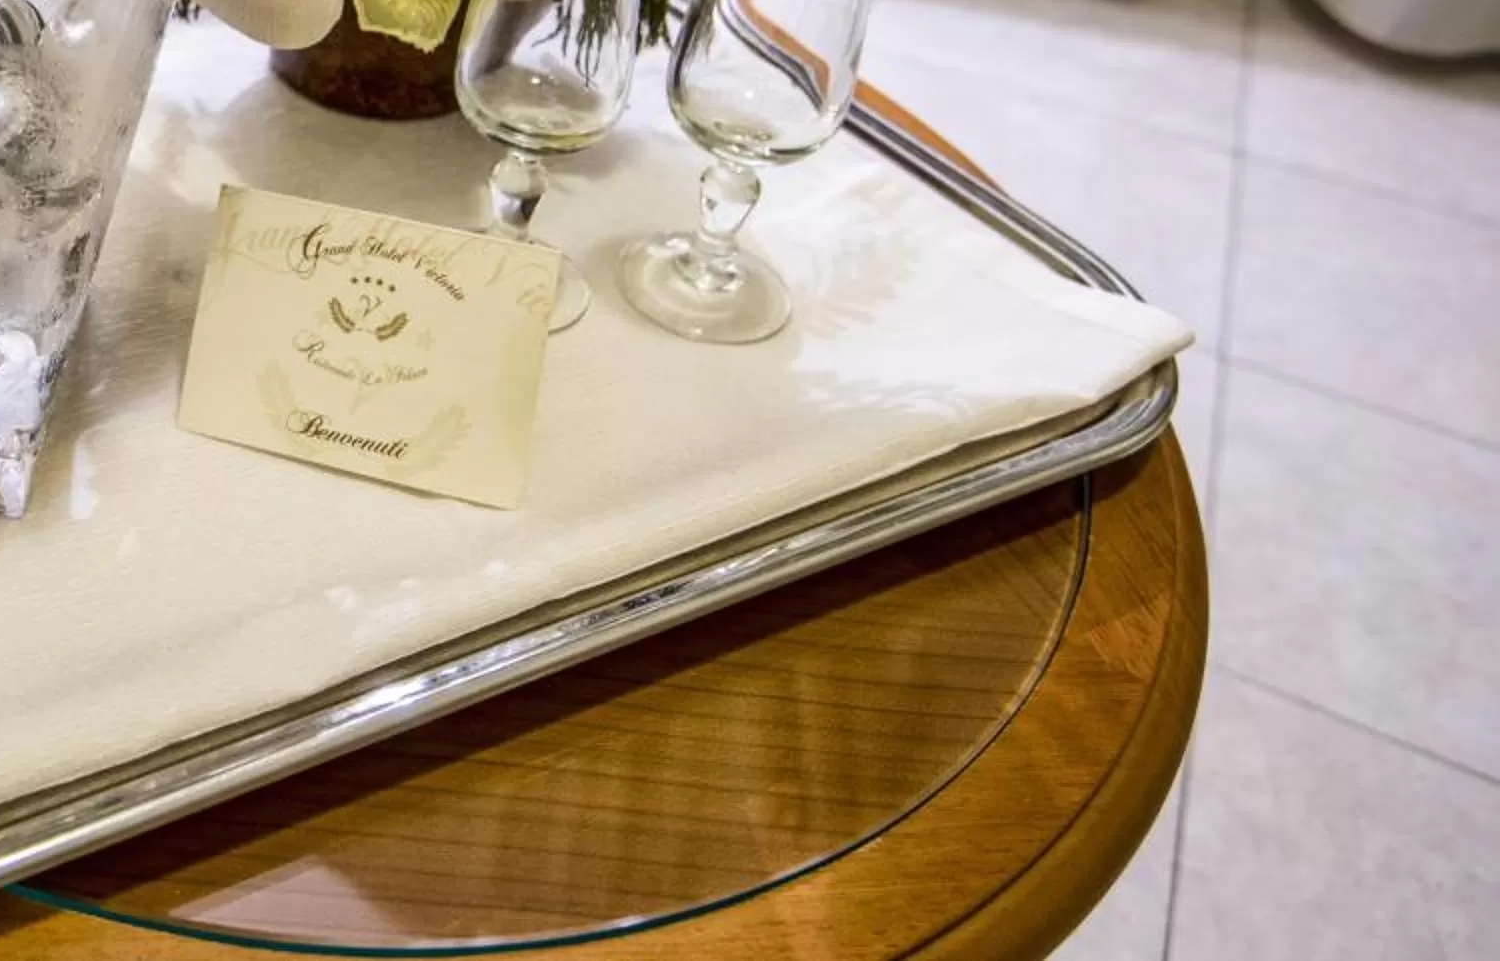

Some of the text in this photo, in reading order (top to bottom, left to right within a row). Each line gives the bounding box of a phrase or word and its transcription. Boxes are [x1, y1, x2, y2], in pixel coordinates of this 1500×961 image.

[287, 223, 356, 279] Grand
[362, 235, 409, 263] Hotel
[287, 409, 408, 460] Benvenuti
